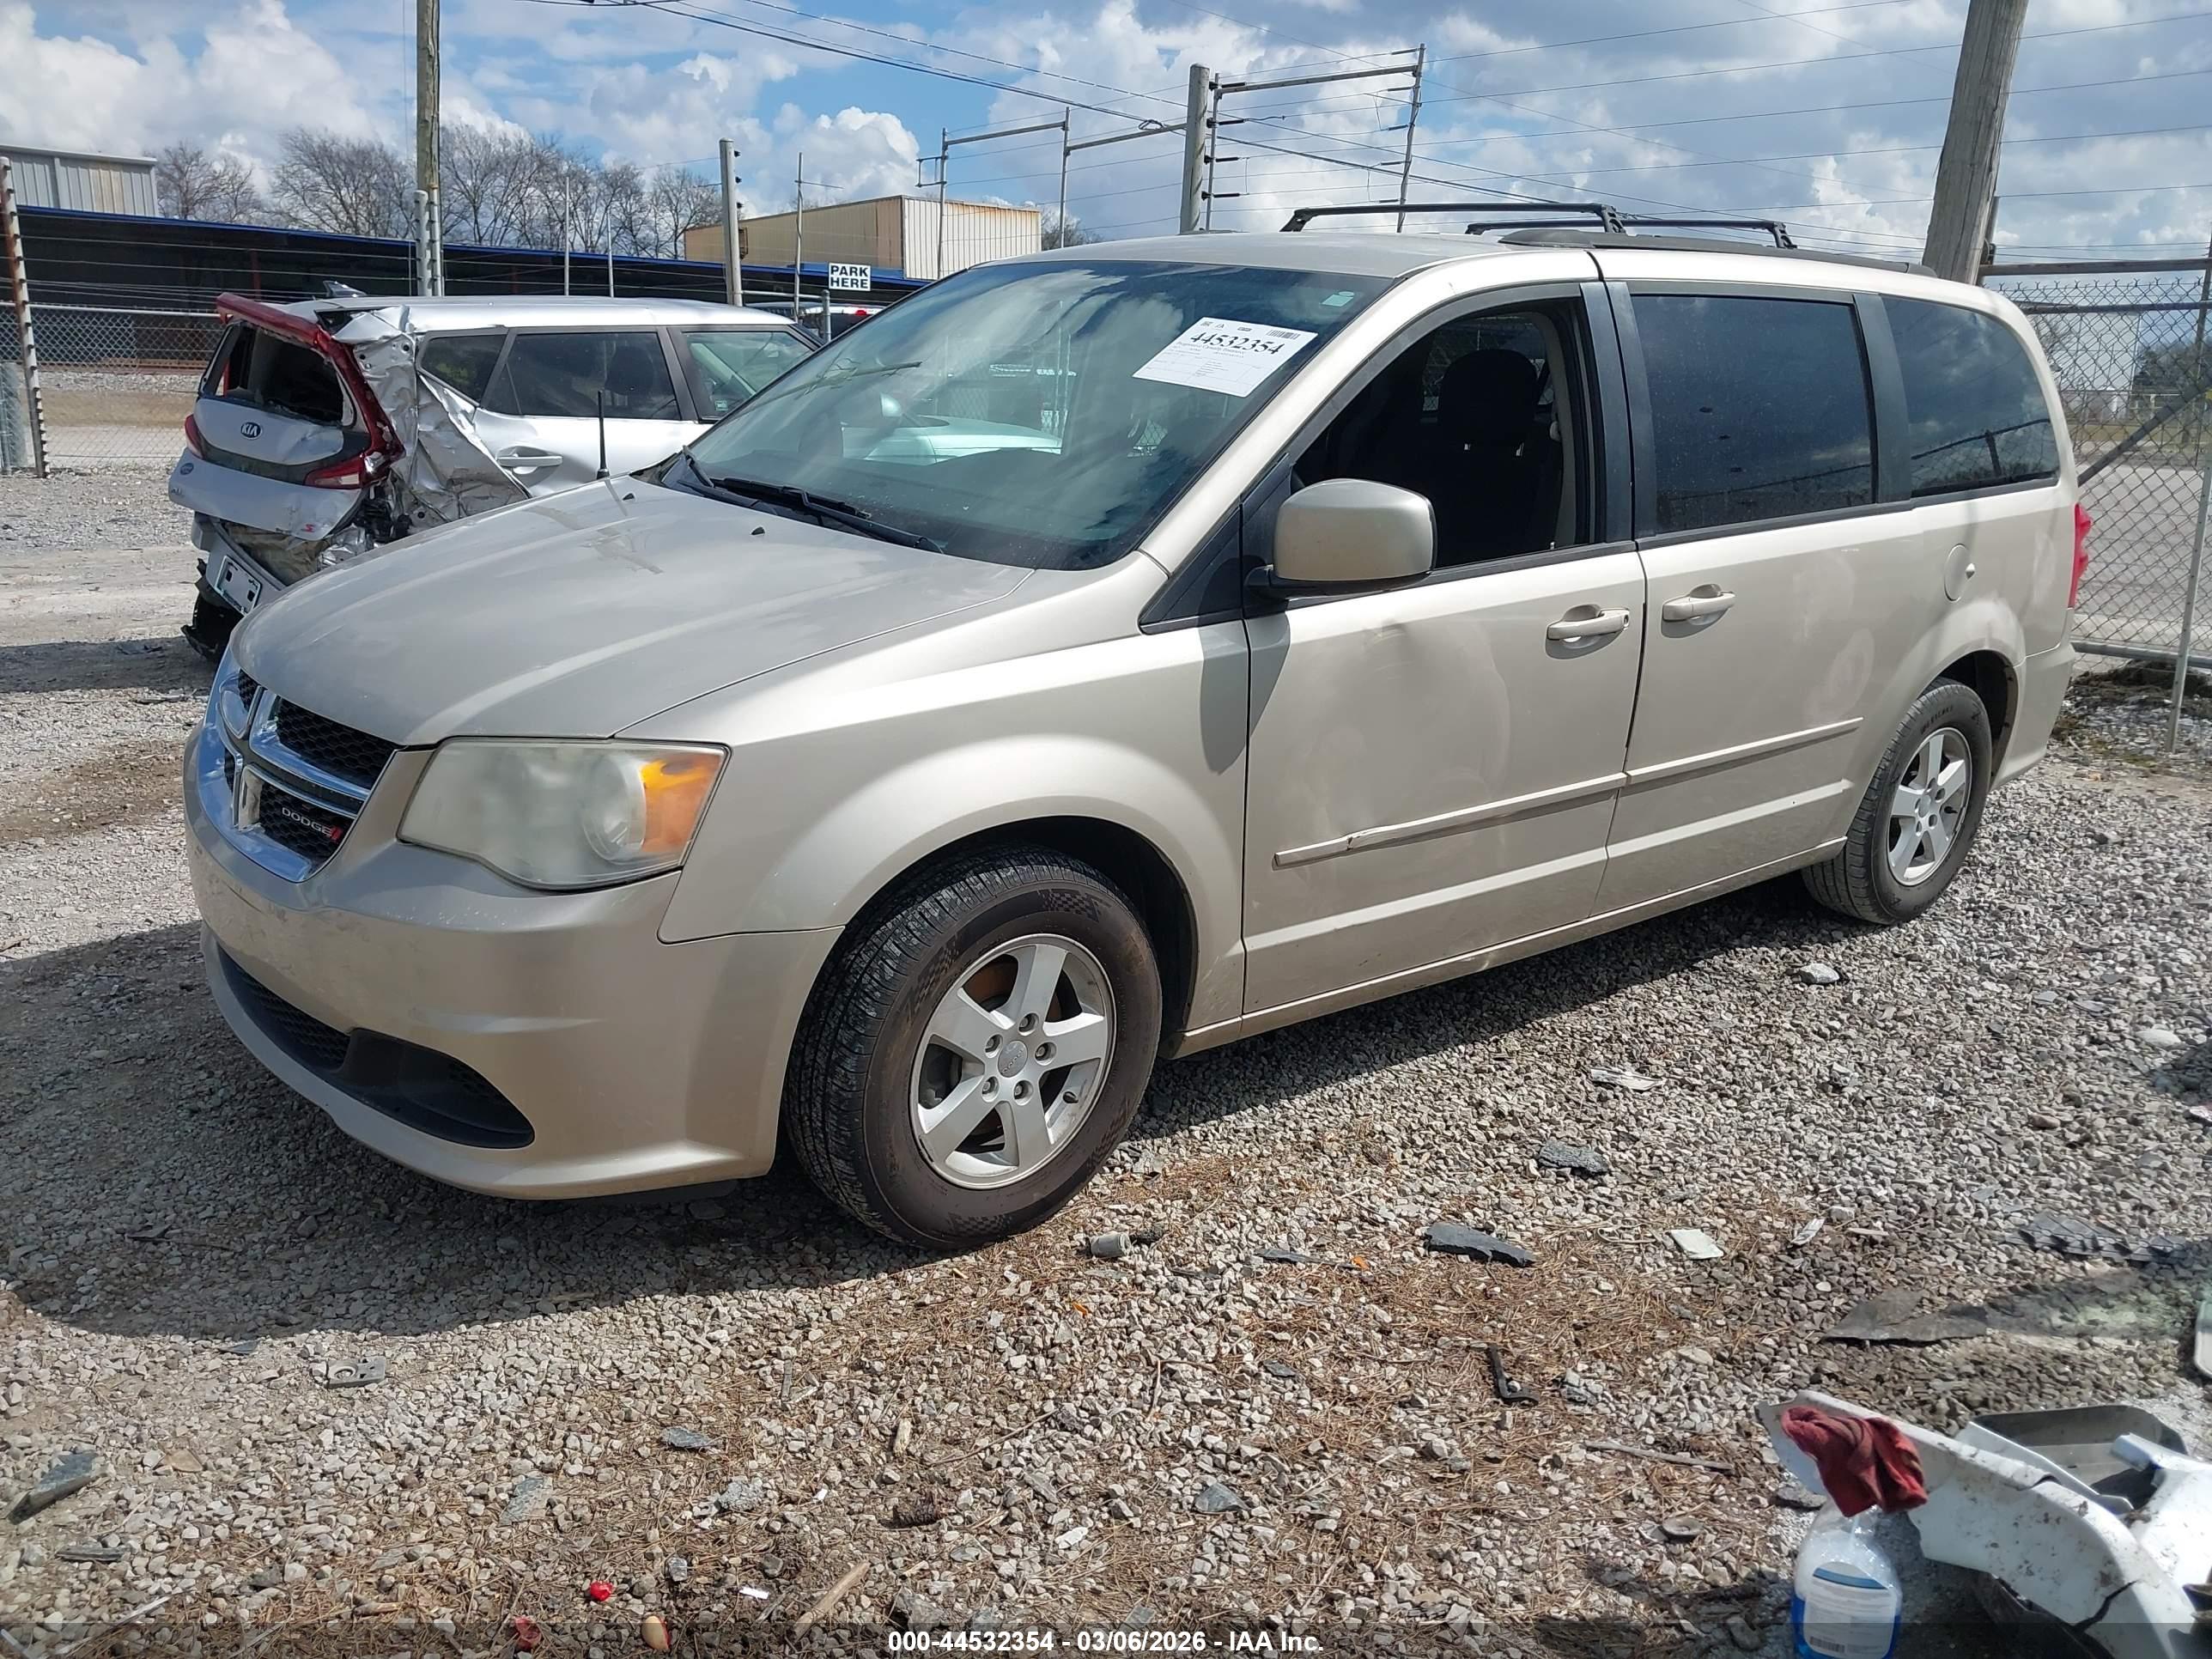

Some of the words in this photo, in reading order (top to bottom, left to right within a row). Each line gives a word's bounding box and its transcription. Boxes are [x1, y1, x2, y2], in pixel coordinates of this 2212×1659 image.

[830, 265, 868, 276] PARK
[830, 276, 868, 289] HERE
[1190, 331, 1285, 355] 44532354
[241, 423, 258, 436] KIA
[282, 807, 332, 837] DODGE
